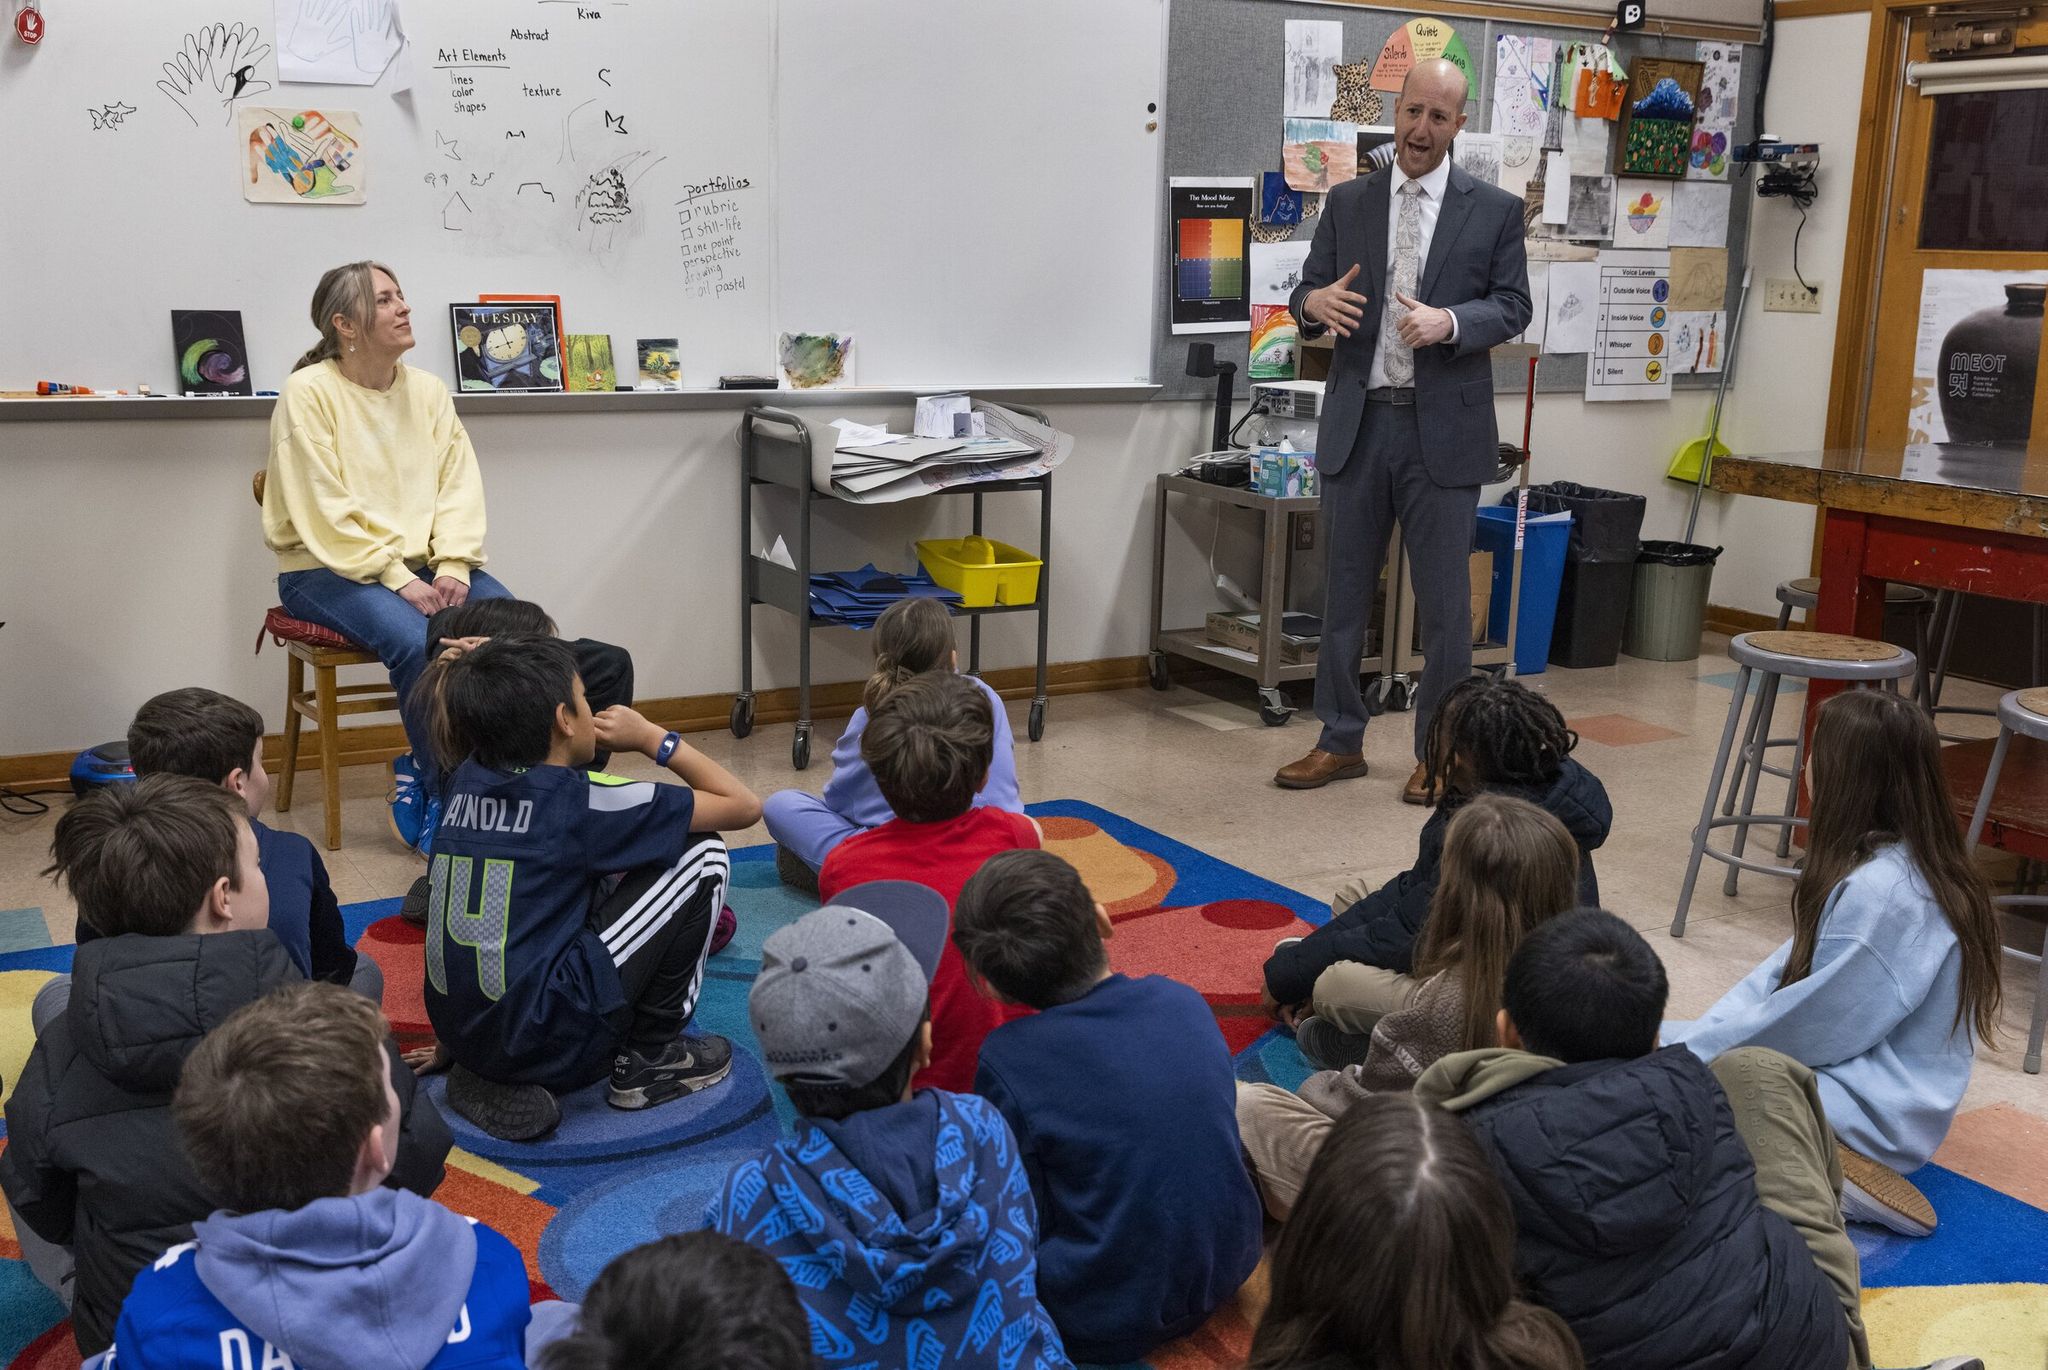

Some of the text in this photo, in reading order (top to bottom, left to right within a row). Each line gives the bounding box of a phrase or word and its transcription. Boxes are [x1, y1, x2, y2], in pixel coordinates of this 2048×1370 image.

[23, 30, 38, 39] STOP
[510, 28, 550, 41] Abstract
[1416, 24, 1438, 37] Quiet
[438, 48, 507, 63] Art Elements
[450, 69, 473, 85] lines
[451, 87, 474, 98] color
[522, 83, 562, 97] texture
[454, 101, 487, 116] shapes
[683, 175, 750, 205] portfolios
[694, 200, 739, 216] rubric
[697, 215, 742, 237] still-life
[693, 235, 735, 255] one point
[683, 247, 741, 275] perspective
[715, 276, 746, 299] pastel
[469, 312, 538, 324] TUESDAY
[1609, 341, 1632, 350] Whisper
[1950, 352, 2007, 373] MEOT
[425, 853, 515, 1002] 14
